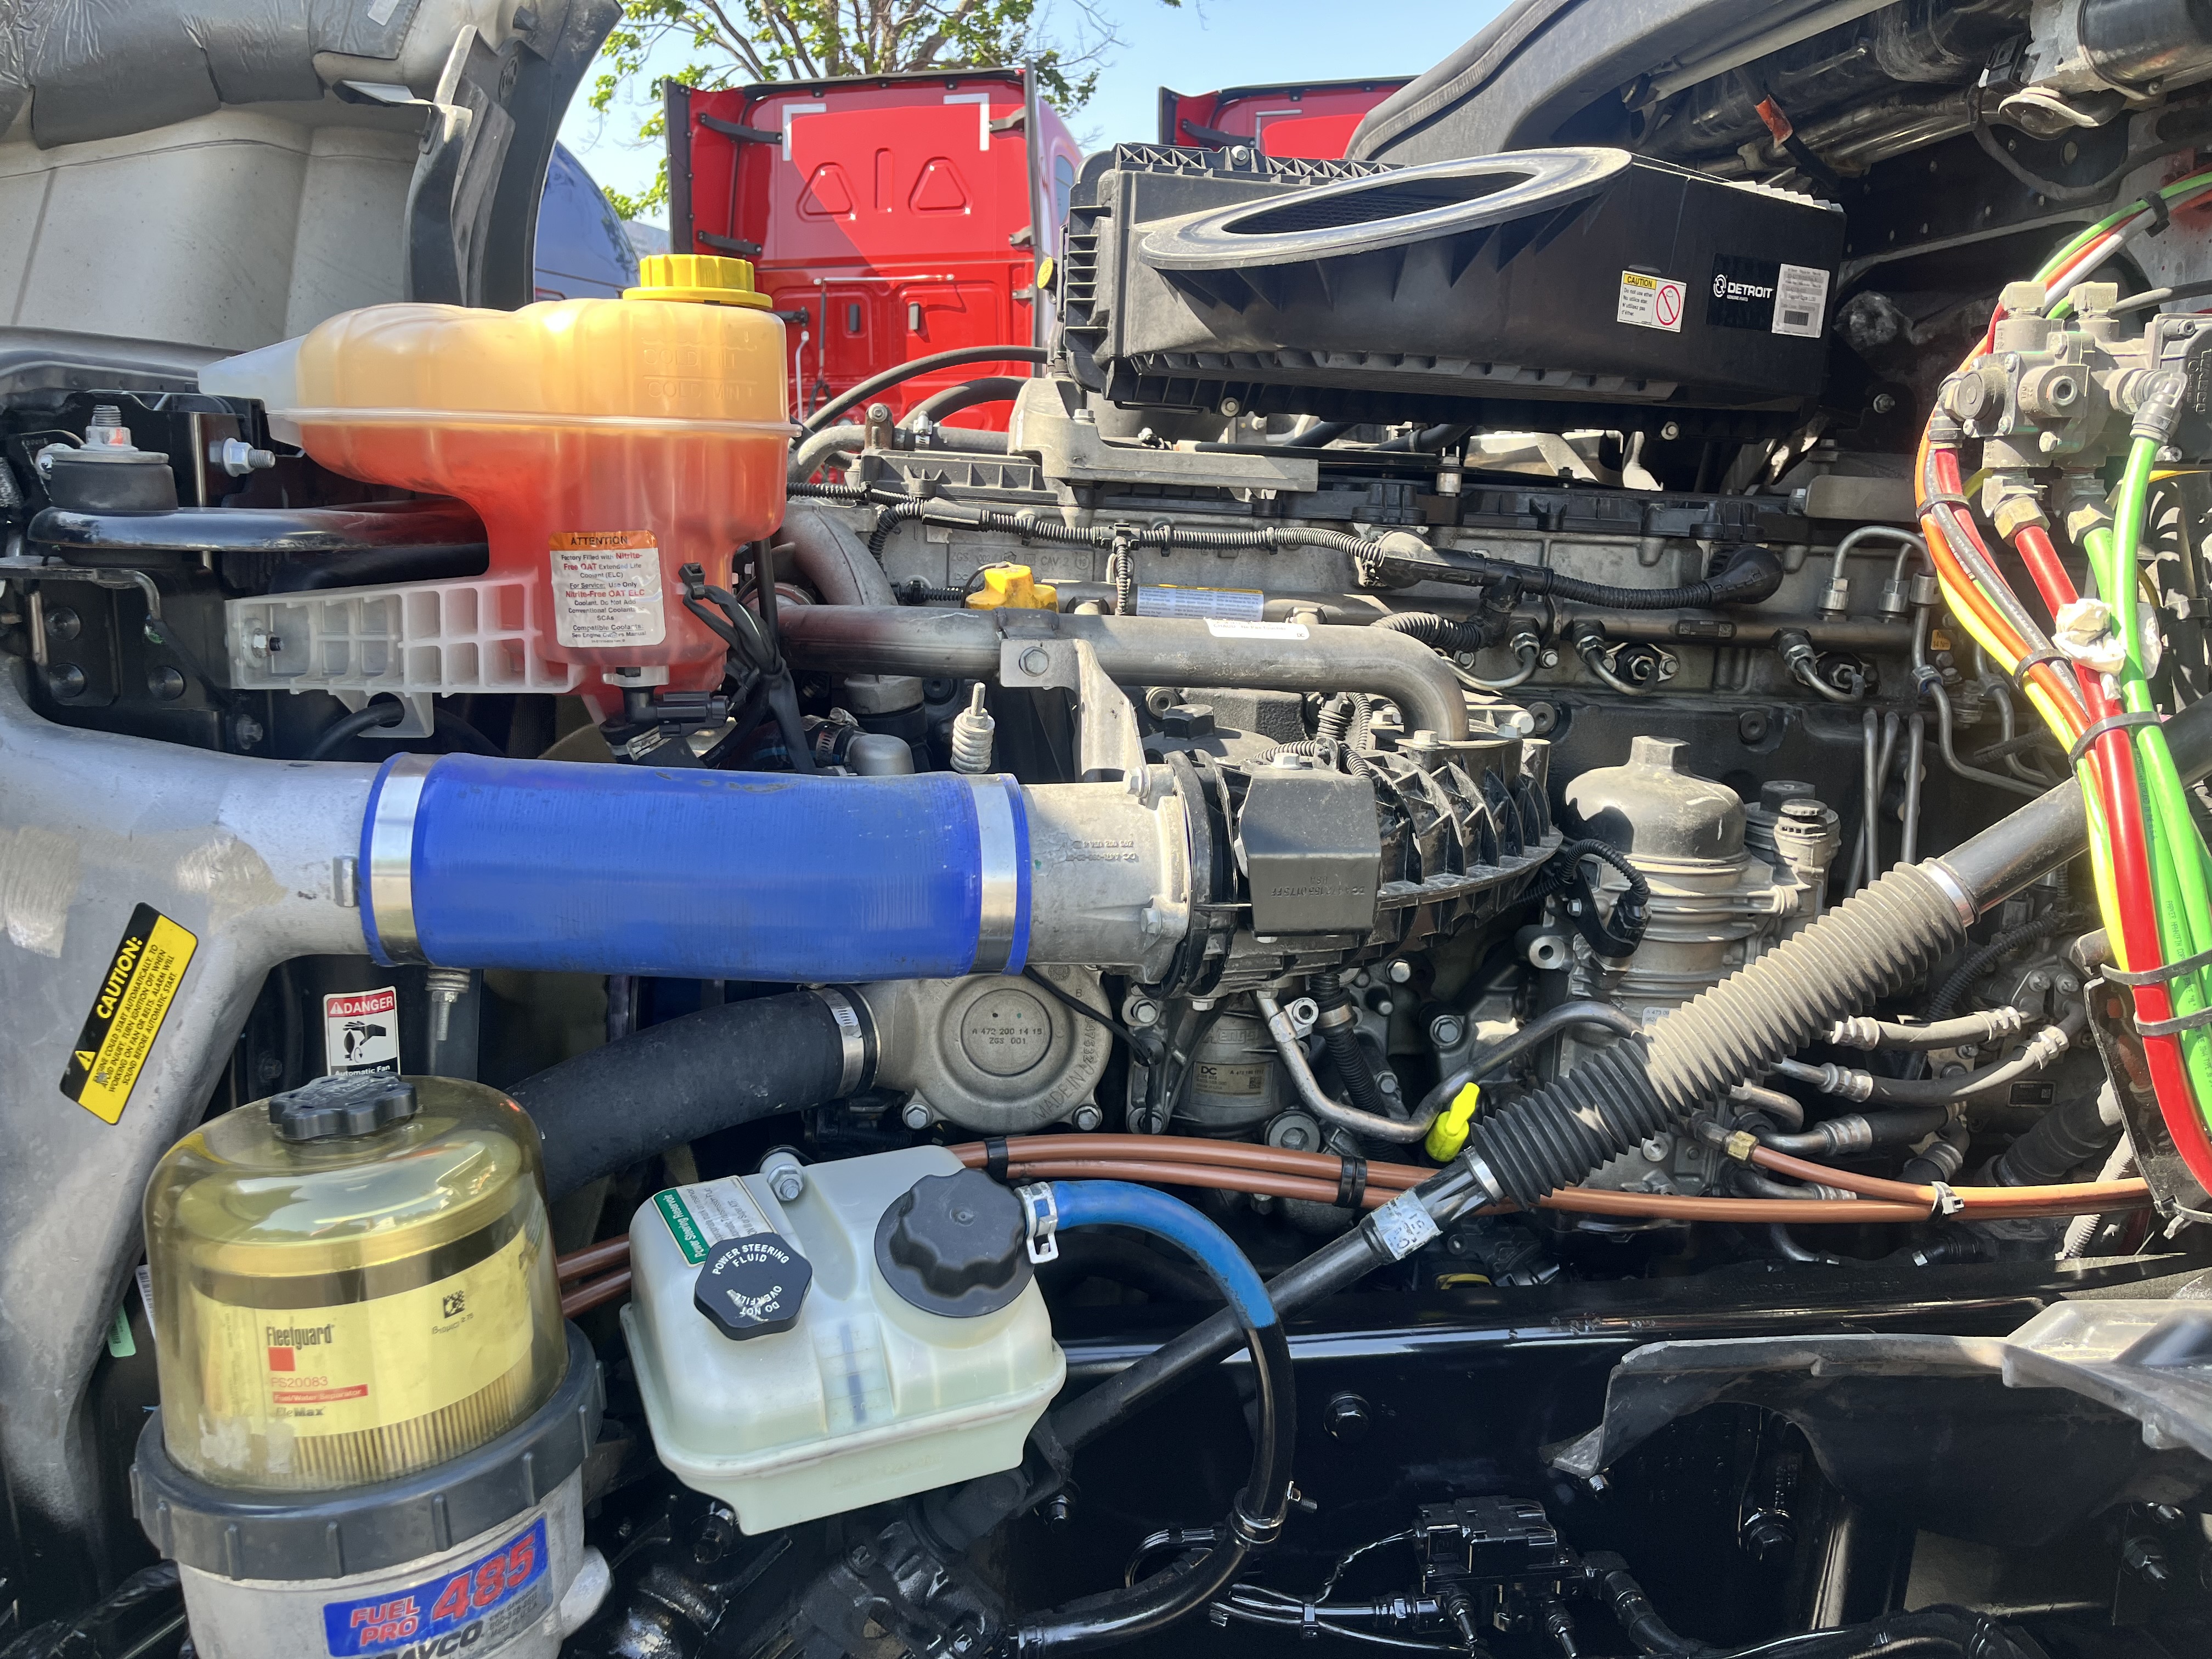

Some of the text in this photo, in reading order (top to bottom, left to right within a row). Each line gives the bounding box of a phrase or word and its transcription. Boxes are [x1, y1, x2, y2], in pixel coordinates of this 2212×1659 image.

[1627, 276, 1652, 287] CAUTION
[1727, 281, 1773, 299] DETROIT
[571, 536, 628, 545] ATTENTION
[950, 552, 969, 562] ZGS
[1041, 555, 1059, 566] CAV
[1310, 876, 1327, 884] USA
[95, 935, 143, 1019] CAUTION:
[103, 1031, 120, 1057] COULD
[114, 1011, 128, 1034] START
[148, 943, 159, 955] TO
[121, 1019, 135, 1040] TURN
[129, 986, 150, 1020] IGNITION
[144, 972, 156, 987] OFF
[151, 948, 167, 973] WHEN
[1075, 989, 1082, 997] B
[343, 996, 393, 1014] DANGER
[107, 1057, 128, 1093] WORKING
[122, 1044, 134, 1058] ON
[128, 1029, 141, 1046] FAN
[135, 1018, 146, 1030] OR
[150, 970, 167, 997] ALARM
[162, 953, 175, 972] WILL
[121, 1059, 138, 1086] SOUND
[132, 1033, 149, 1060] BEFORE
[144, 992, 168, 1034] AUTOMATIC
[335, 1064, 391, 1076] Automatic Fan
[1201, 1065, 1217, 1075] DC
[1031, 1084, 1074, 1120] MADE
[663, 1194, 706, 1259] Power Steering Reservoir
[712, 1243, 790, 1275] POWER STEERING
[732, 1253, 768, 1267] FLUID
[735, 1285, 783, 1306] OVERFILL
[741, 1302, 780, 1316] DO NOT
[266, 1324, 334, 1351] Fleetguard
[274, 1388, 363, 1403] Fuel/Water Separator
[431, 1532, 536, 1621] 485
[351, 1596, 421, 1628] FUEL
[359, 1617, 419, 1647] PRO
